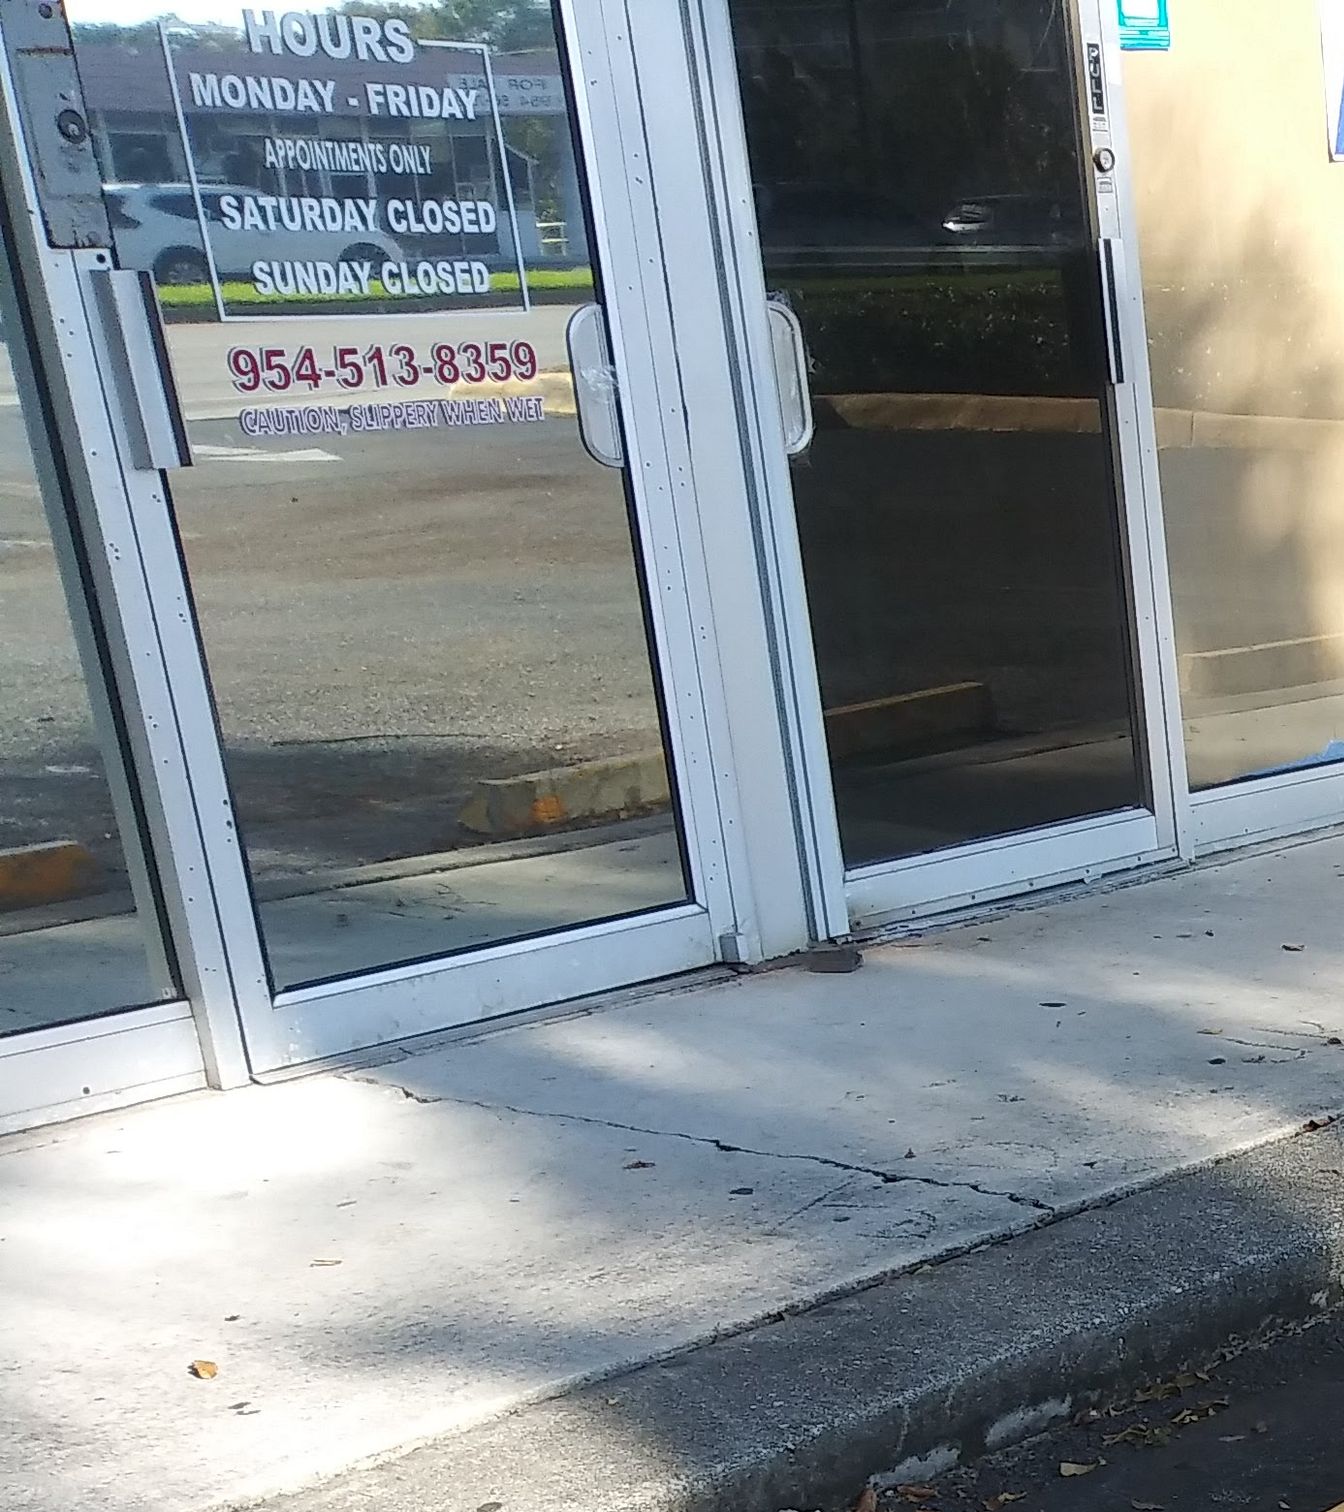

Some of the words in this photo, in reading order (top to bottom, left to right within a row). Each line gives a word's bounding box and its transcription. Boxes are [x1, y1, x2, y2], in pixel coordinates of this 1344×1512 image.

[242, 8, 415, 64] HOURS
[189, 72, 336, 113] MONDAY
[365, 82, 477, 120] FRIDAY
[1089, 47, 1103, 111] PULL
[263, 137, 386, 174] APPOINTMENTS
[388, 143, 432, 175] ONLY
[218, 195, 378, 233] SATURDAY
[387, 199, 497, 234] CLOSED
[252, 260, 372, 296] SUNDAY
[381, 261, 490, 294] CLOSED
[228, 340, 538, 392] 954-513-8359
[240, 406, 347, 436] CAUTION,
[350, 402, 439, 431] SLIPPERY
[441, 399, 503, 426] WHEN
[507, 397, 546, 422] WET
